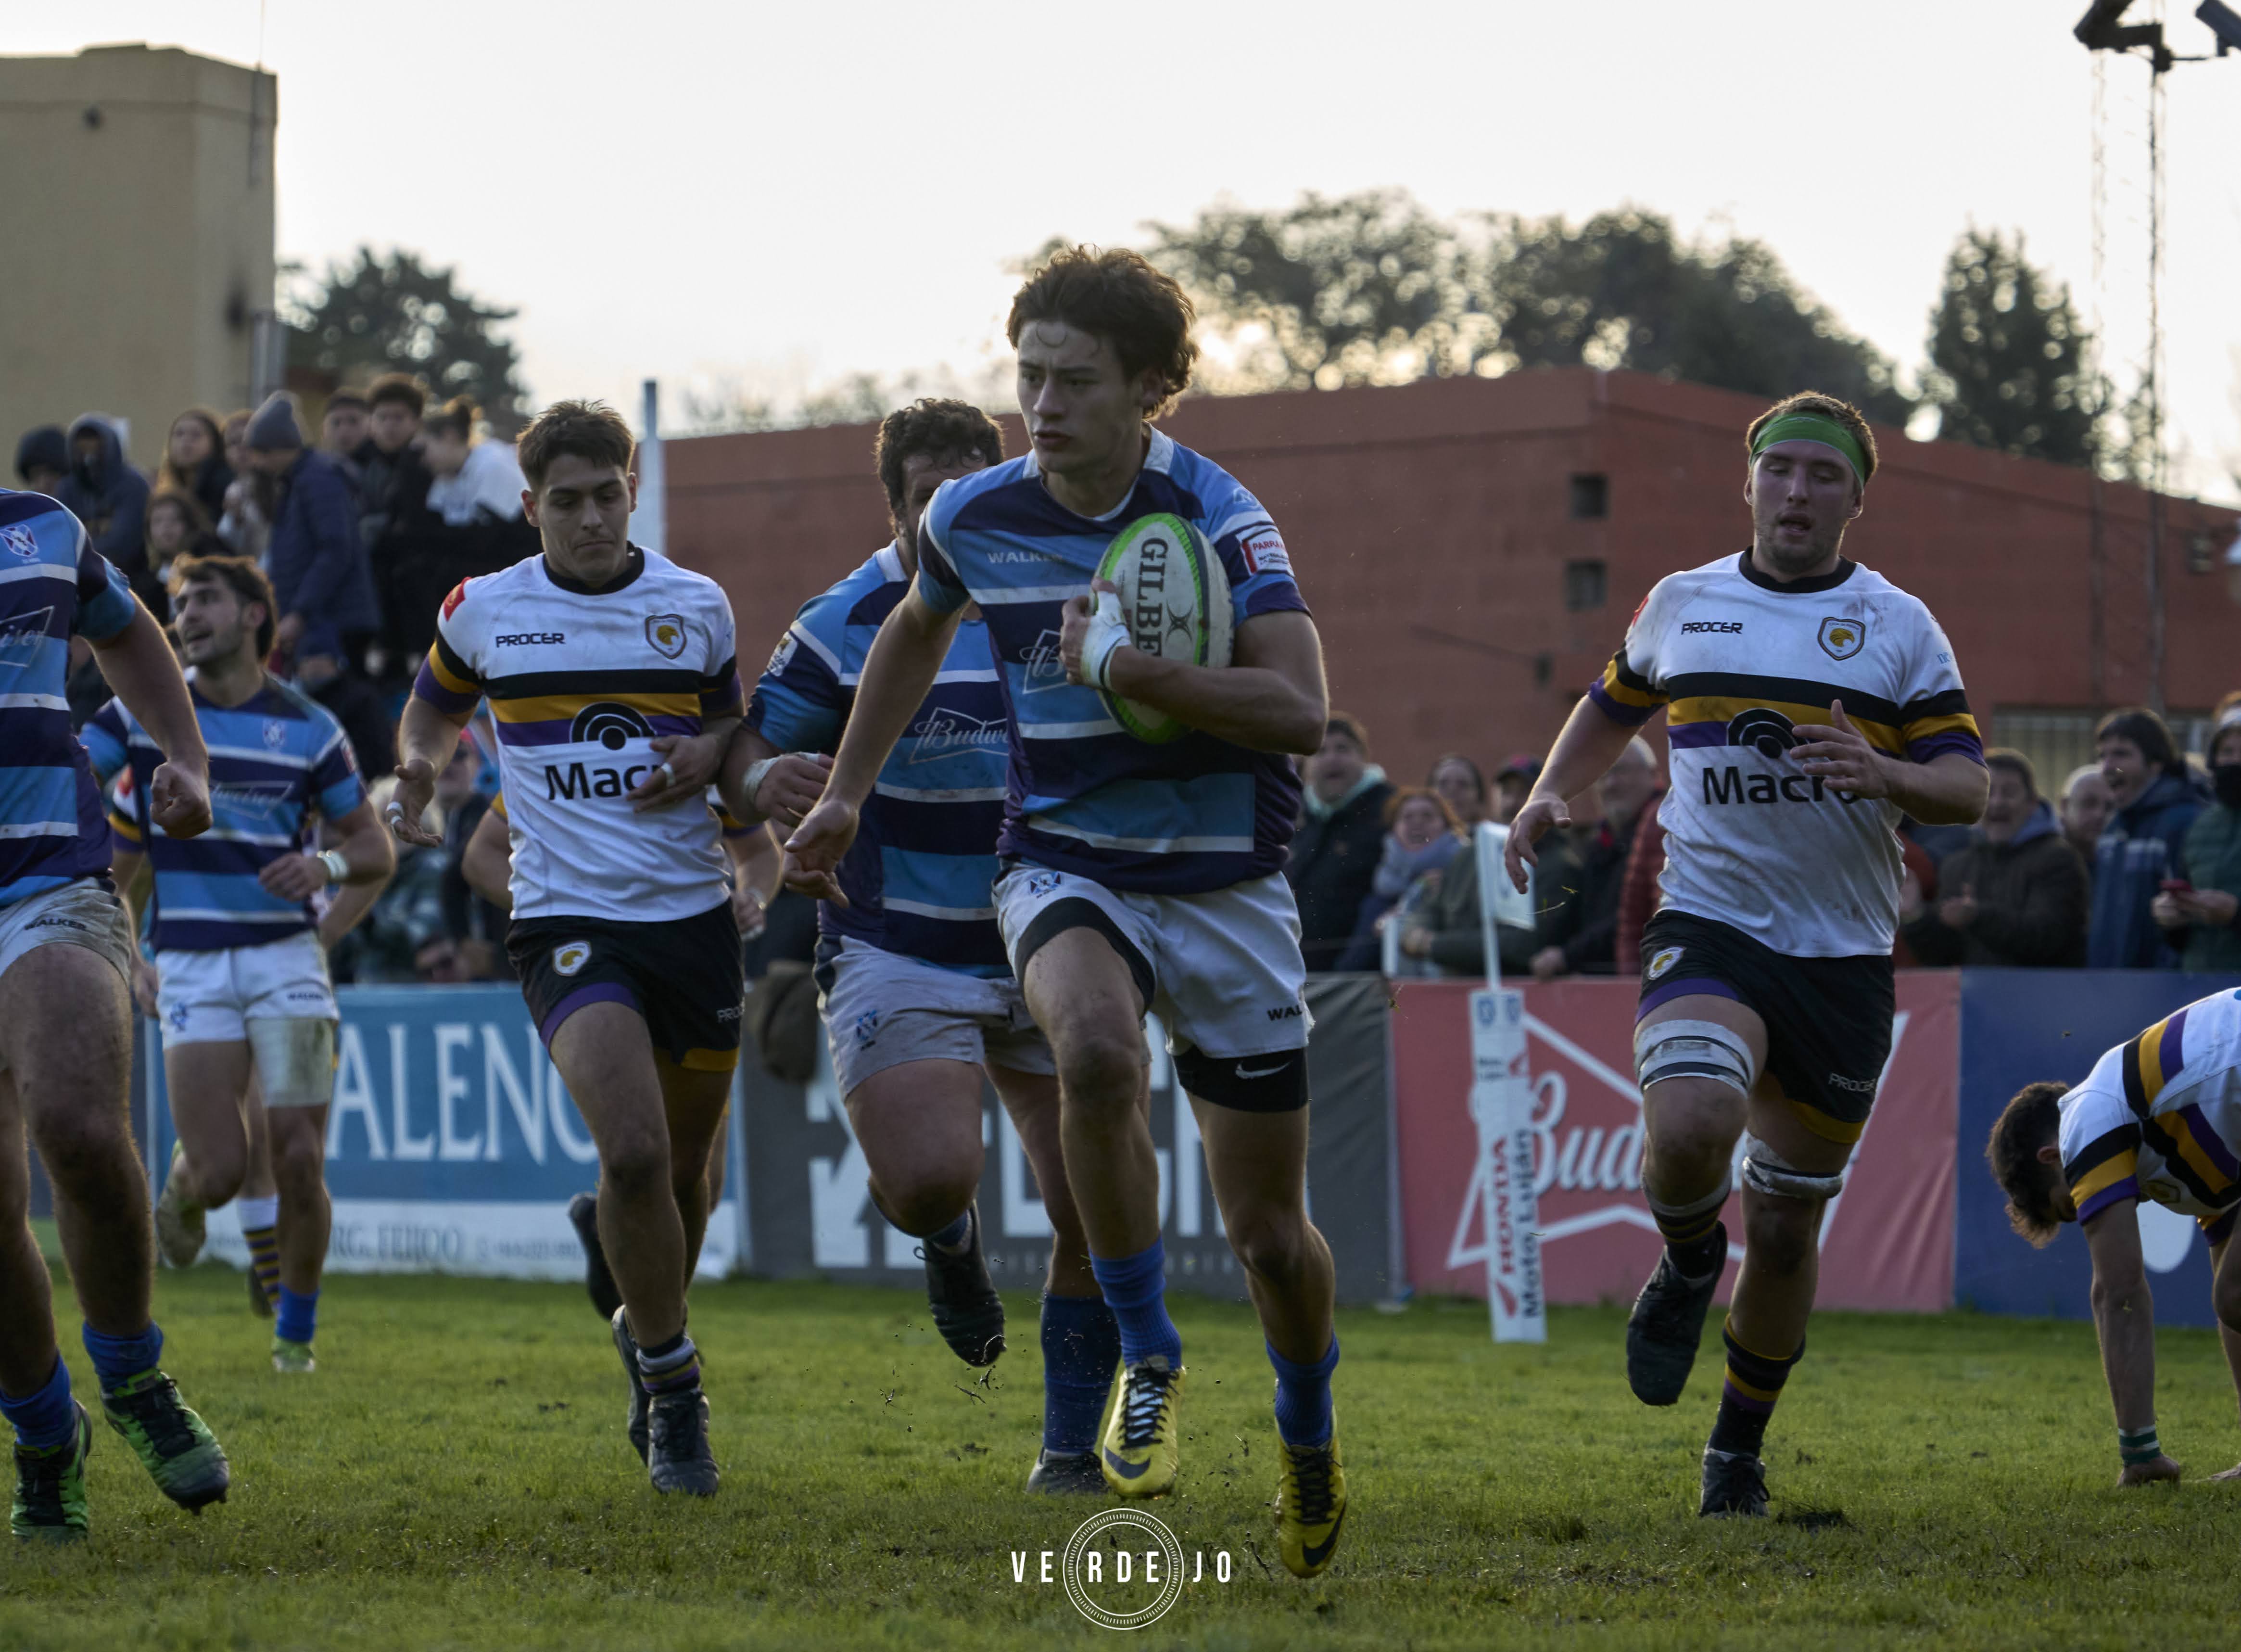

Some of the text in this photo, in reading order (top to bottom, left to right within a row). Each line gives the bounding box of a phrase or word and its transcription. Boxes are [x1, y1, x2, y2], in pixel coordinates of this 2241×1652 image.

[1681, 622, 1743, 635] PROCER
[495, 633, 566, 648] PROCER
[544, 762, 661, 801] Mac
